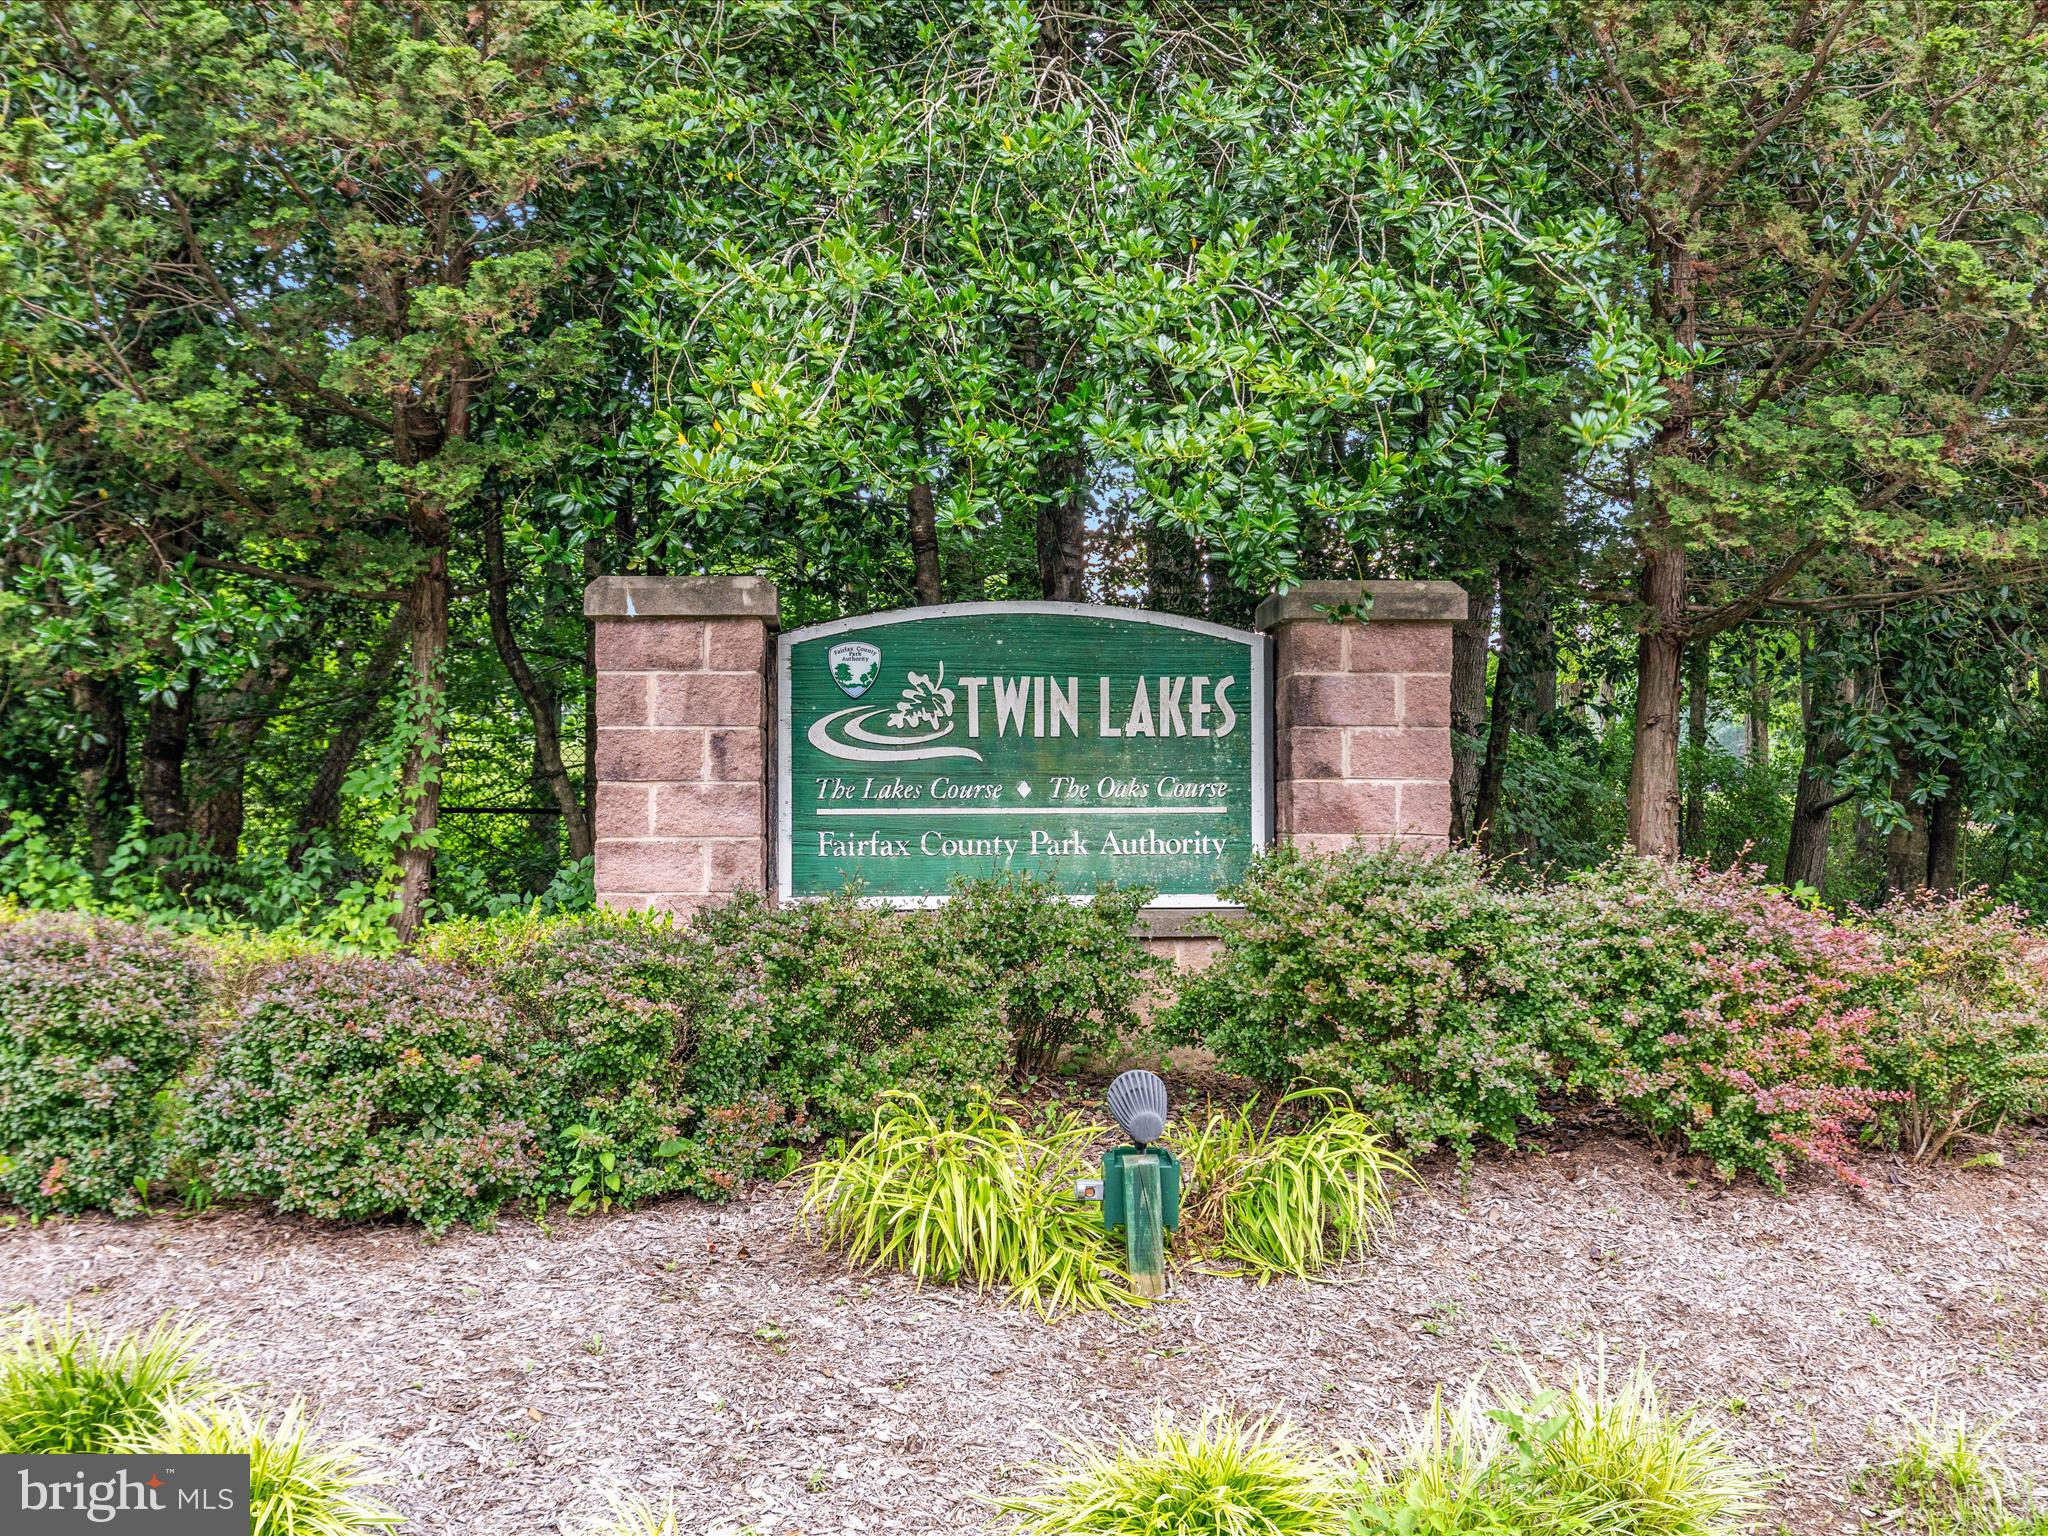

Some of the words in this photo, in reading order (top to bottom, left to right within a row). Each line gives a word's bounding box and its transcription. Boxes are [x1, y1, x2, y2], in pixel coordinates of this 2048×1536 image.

[833, 646, 854, 656] Fairfax
[856, 646, 878, 656] County
[958, 676, 1079, 739] TWIN
[1099, 675, 1236, 739] LAKES
[815, 777, 857, 800] The
[862, 777, 922, 800] Lakes
[930, 777, 1003, 800] Course
[1049, 776, 1090, 799] The
[1096, 776, 1149, 799] Oaks
[1155, 776, 1228, 799] Course
[817, 831, 911, 858] Fairfax
[920, 831, 1019, 862] County
[1030, 831, 1088, 857] Park
[1100, 829, 1227, 860] Authority
